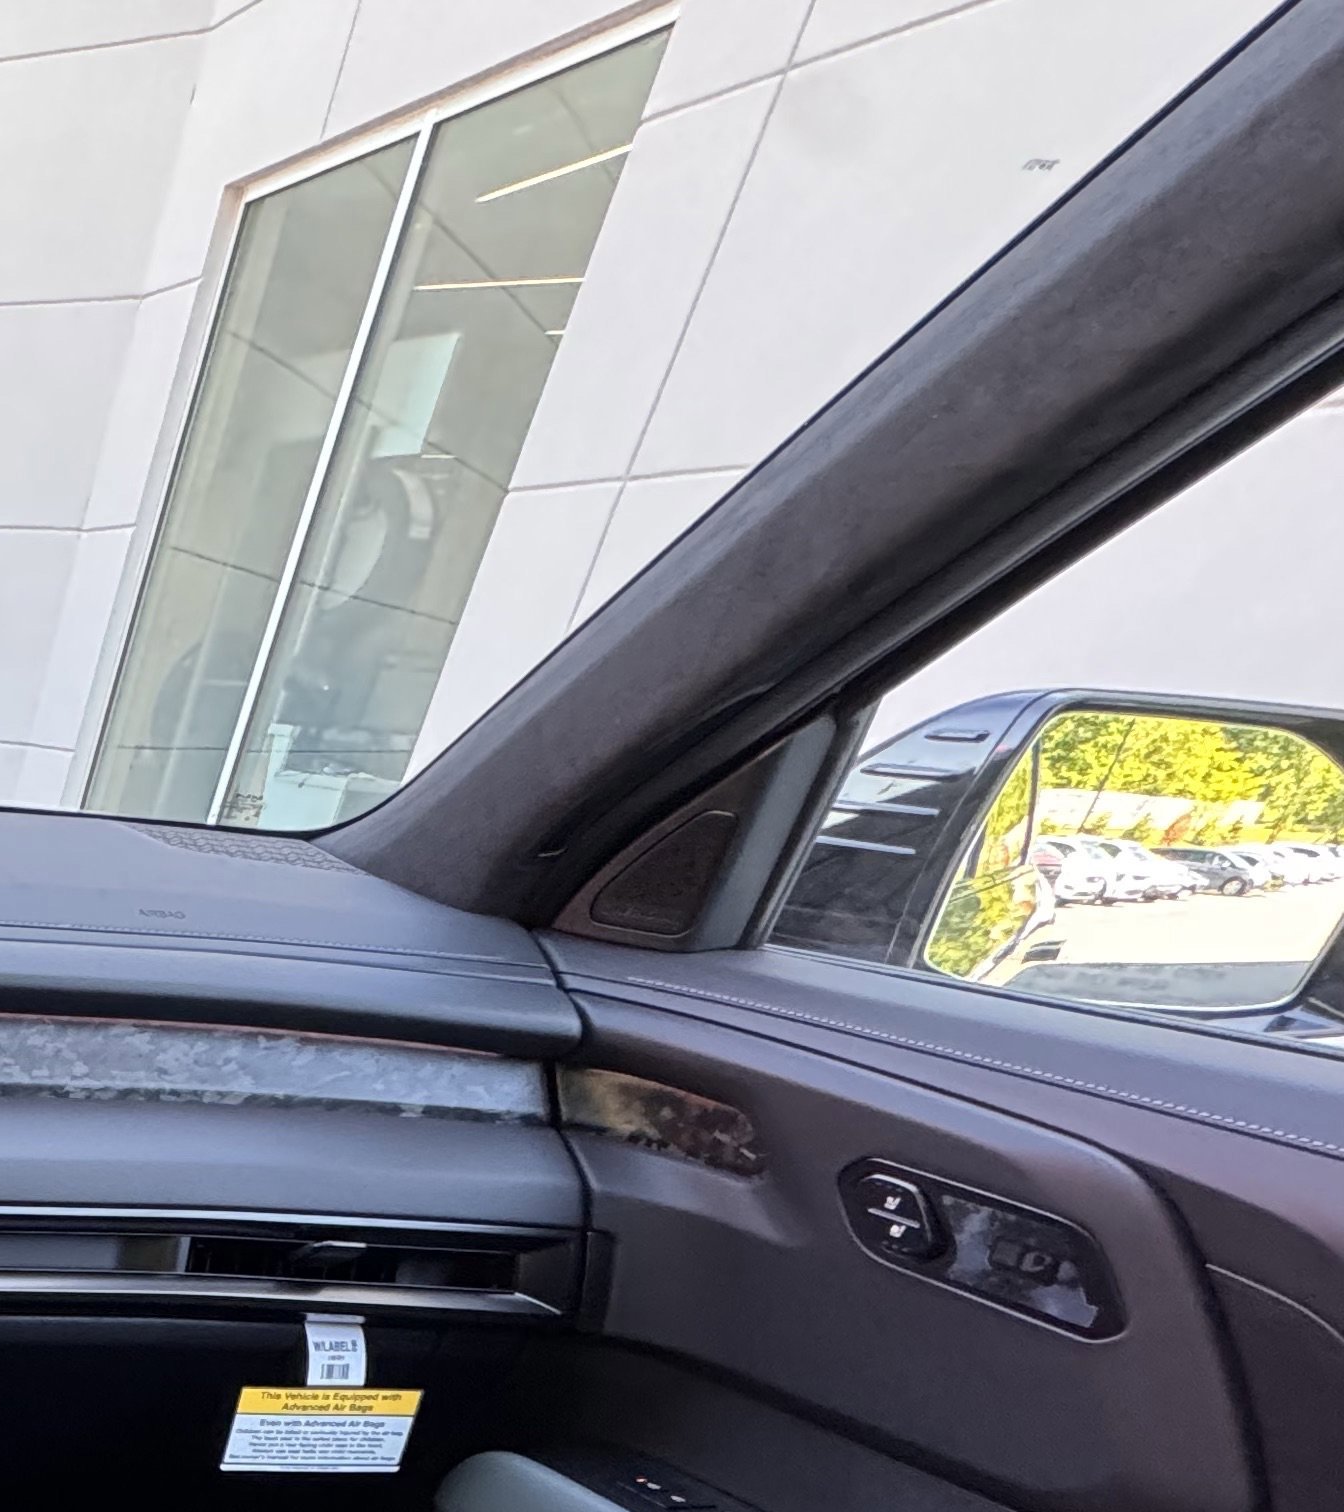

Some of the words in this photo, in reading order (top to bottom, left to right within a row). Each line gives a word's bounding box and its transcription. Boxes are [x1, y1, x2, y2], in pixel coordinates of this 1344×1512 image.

[261, 1391, 282, 1400] This
[285, 1391, 319, 1400] Vehicle
[333, 1392, 380, 1403] Equipped
[381, 1393, 403, 1402] with
[281, 1402, 331, 1411] Advanced
[332, 1403, 348, 1411] Air
